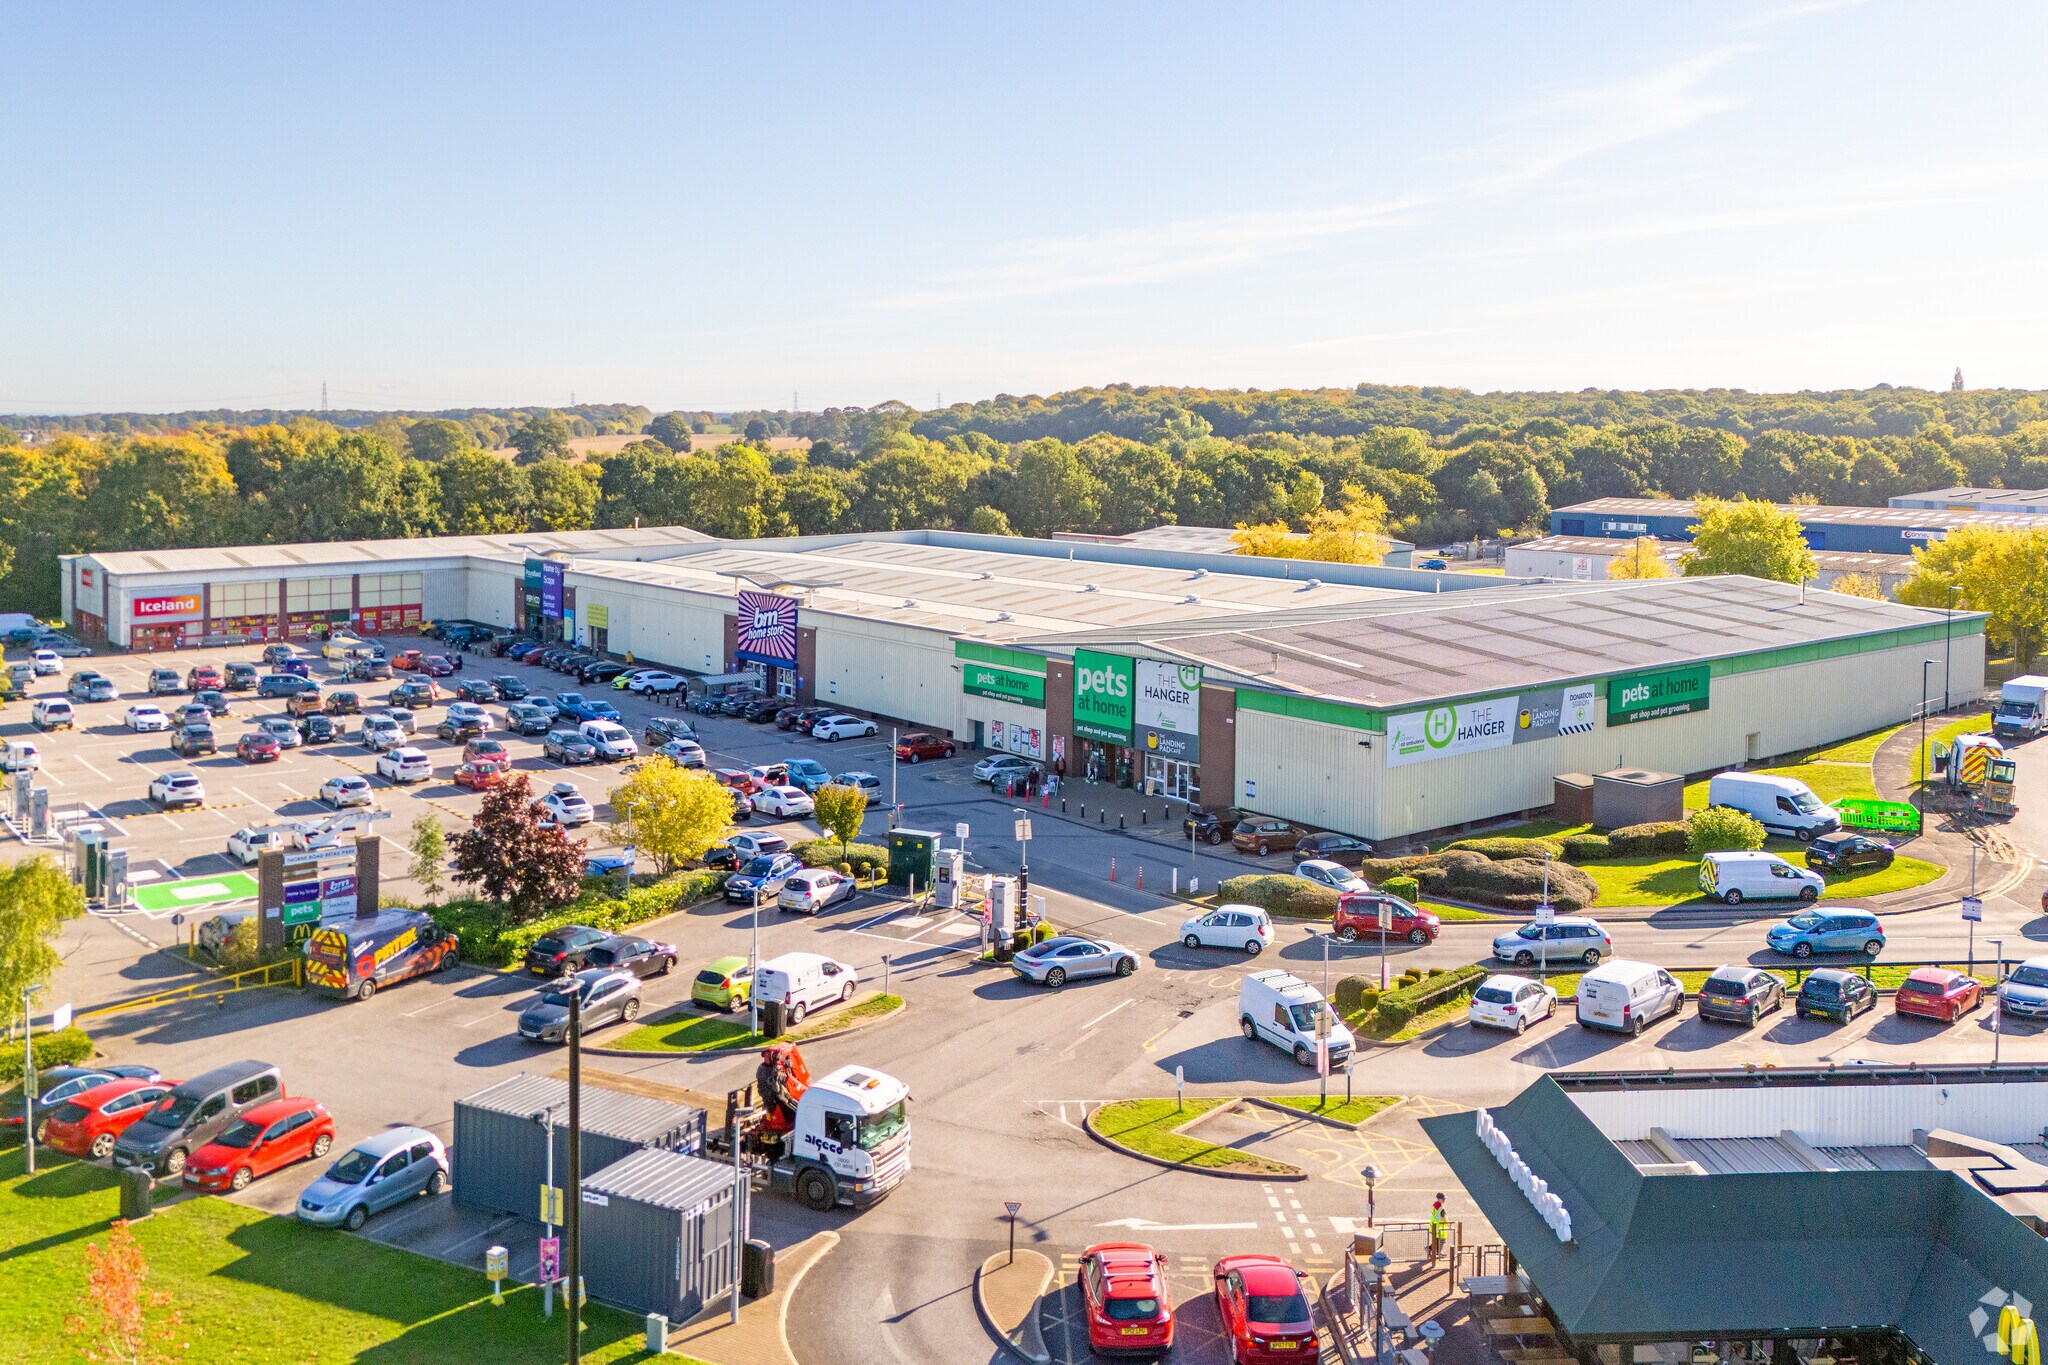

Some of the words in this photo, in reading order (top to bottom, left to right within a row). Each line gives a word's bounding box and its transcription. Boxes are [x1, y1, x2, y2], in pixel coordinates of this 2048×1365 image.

[543, 563, 555, 573] Home
[543, 575, 555, 586] Scope
[140, 598, 195, 613] Iceland
[754, 606, 778, 629] bm
[747, 628, 767, 640] home
[767, 625, 784, 638] store
[977, 672, 995, 685] pets
[995, 675, 1005, 687] at
[1006, 675, 1029, 691] home
[1078, 665, 1128, 698] pets
[1157, 673, 1177, 689] THE
[1145, 685, 1190, 705] HANGER
[1569, 692, 1593, 701] DONATION
[1622, 682, 1650, 708] pets
[1651, 681, 1663, 698] at
[1666, 677, 1699, 695] home
[1078, 694, 1091, 710] at
[1092, 694, 1127, 718] home
[1572, 700, 1590, 708] STATION
[1471, 707, 1492, 723] THE
[1532, 708, 1560, 721] LANDING
[1630, 711, 1639, 722] pet
[1638, 710, 1651, 719] shop
[1651, 707, 1660, 716] and
[1660, 708, 1669, 717] pet
[1668, 703, 1691, 715] grooming
[1434, 713, 1448, 736] H
[1458, 720, 1505, 741] HANGER
[1532, 718, 1544, 728] PAD
[1084, 726, 1093, 734] shop
[1093, 727, 1101, 735] and
[1108, 731, 1127, 742] grooming
[1159, 738, 1185, 750] LANDING
[1159, 744, 1170, 754] PAD
[287, 855, 308, 863] THORNE
[308, 852, 324, 860] ROAD
[290, 904, 314, 917] pets
[373, 926, 418, 966] PIRTEK
